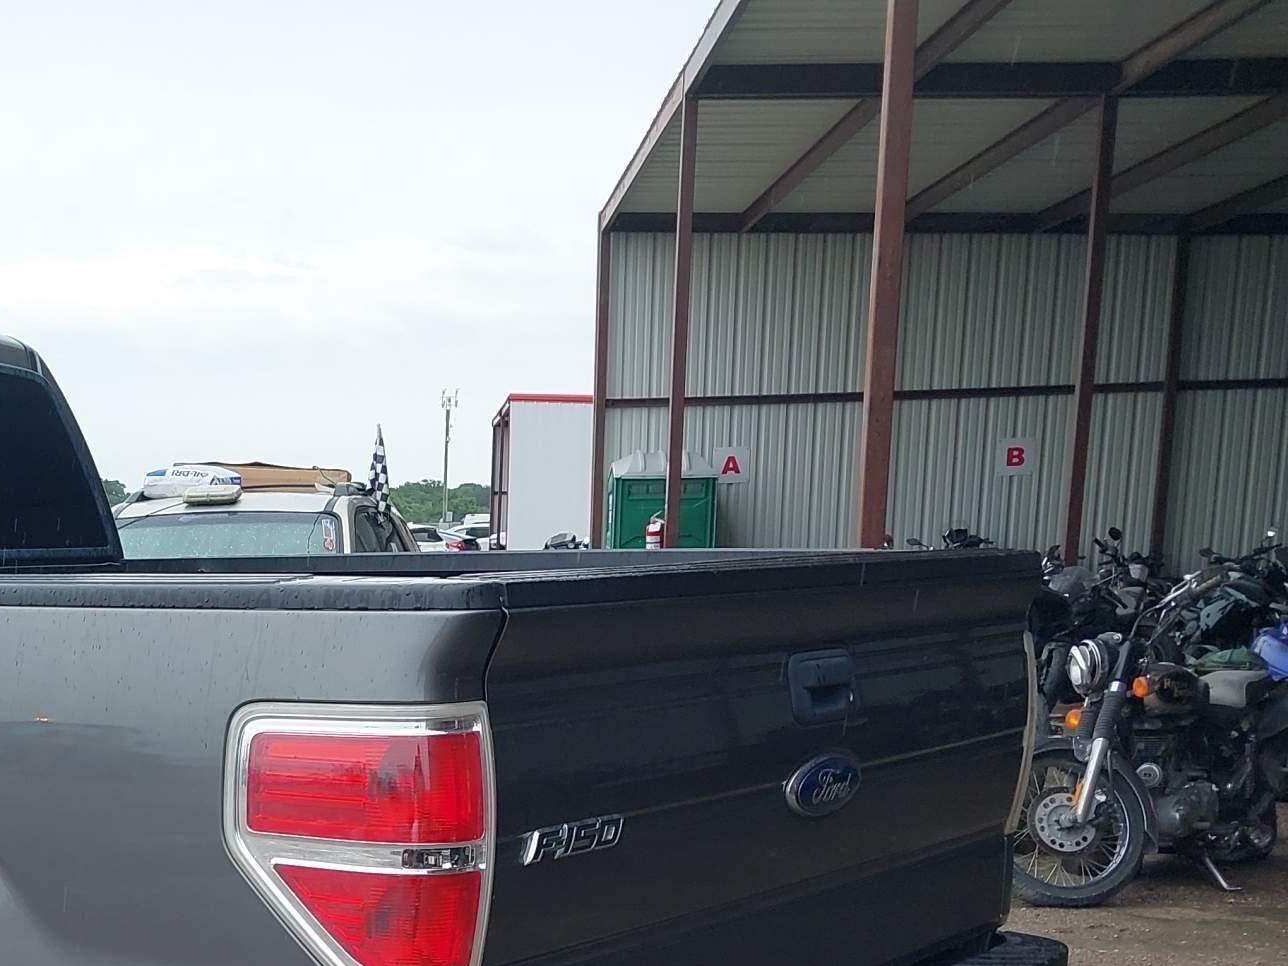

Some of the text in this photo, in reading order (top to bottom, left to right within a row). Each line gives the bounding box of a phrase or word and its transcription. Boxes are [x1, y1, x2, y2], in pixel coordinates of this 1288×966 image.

[722, 456, 740, 473] A
[1007, 448, 1024, 465] B
[811, 767, 852, 804] Ford
